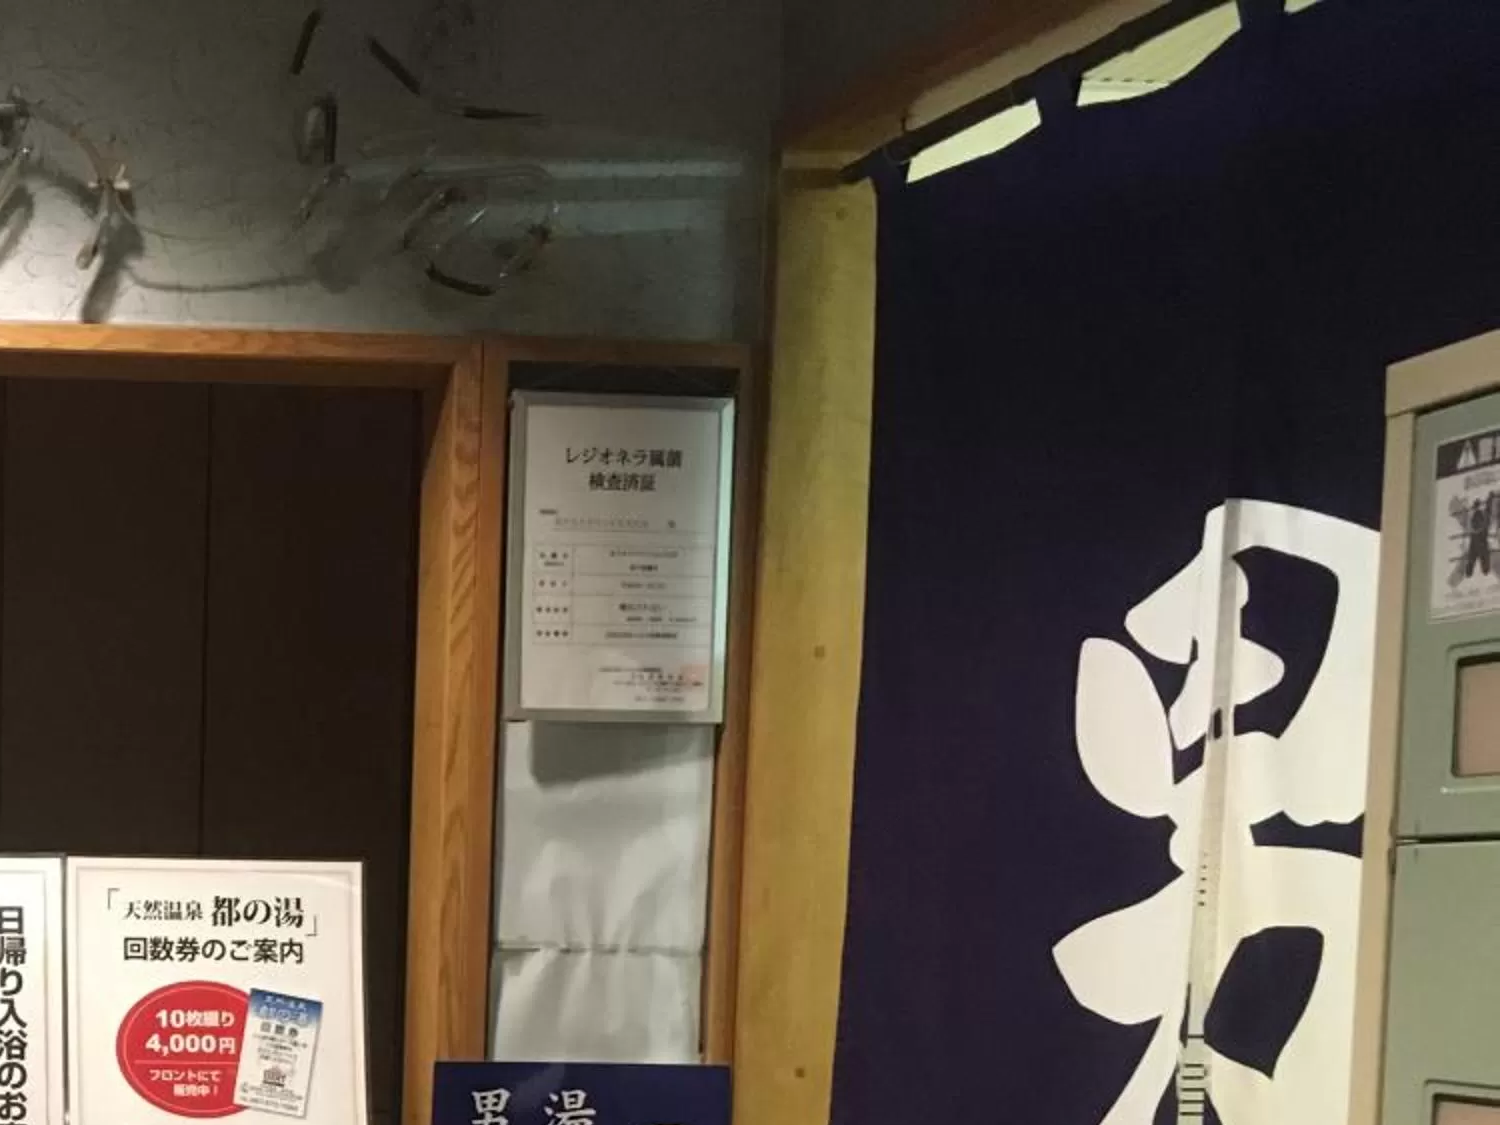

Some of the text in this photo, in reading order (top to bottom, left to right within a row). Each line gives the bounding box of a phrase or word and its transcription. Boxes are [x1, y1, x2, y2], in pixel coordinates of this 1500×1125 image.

[123, 936, 304, 964] 回数券のご案内
[145, 1033, 236, 1056] 4,000円
